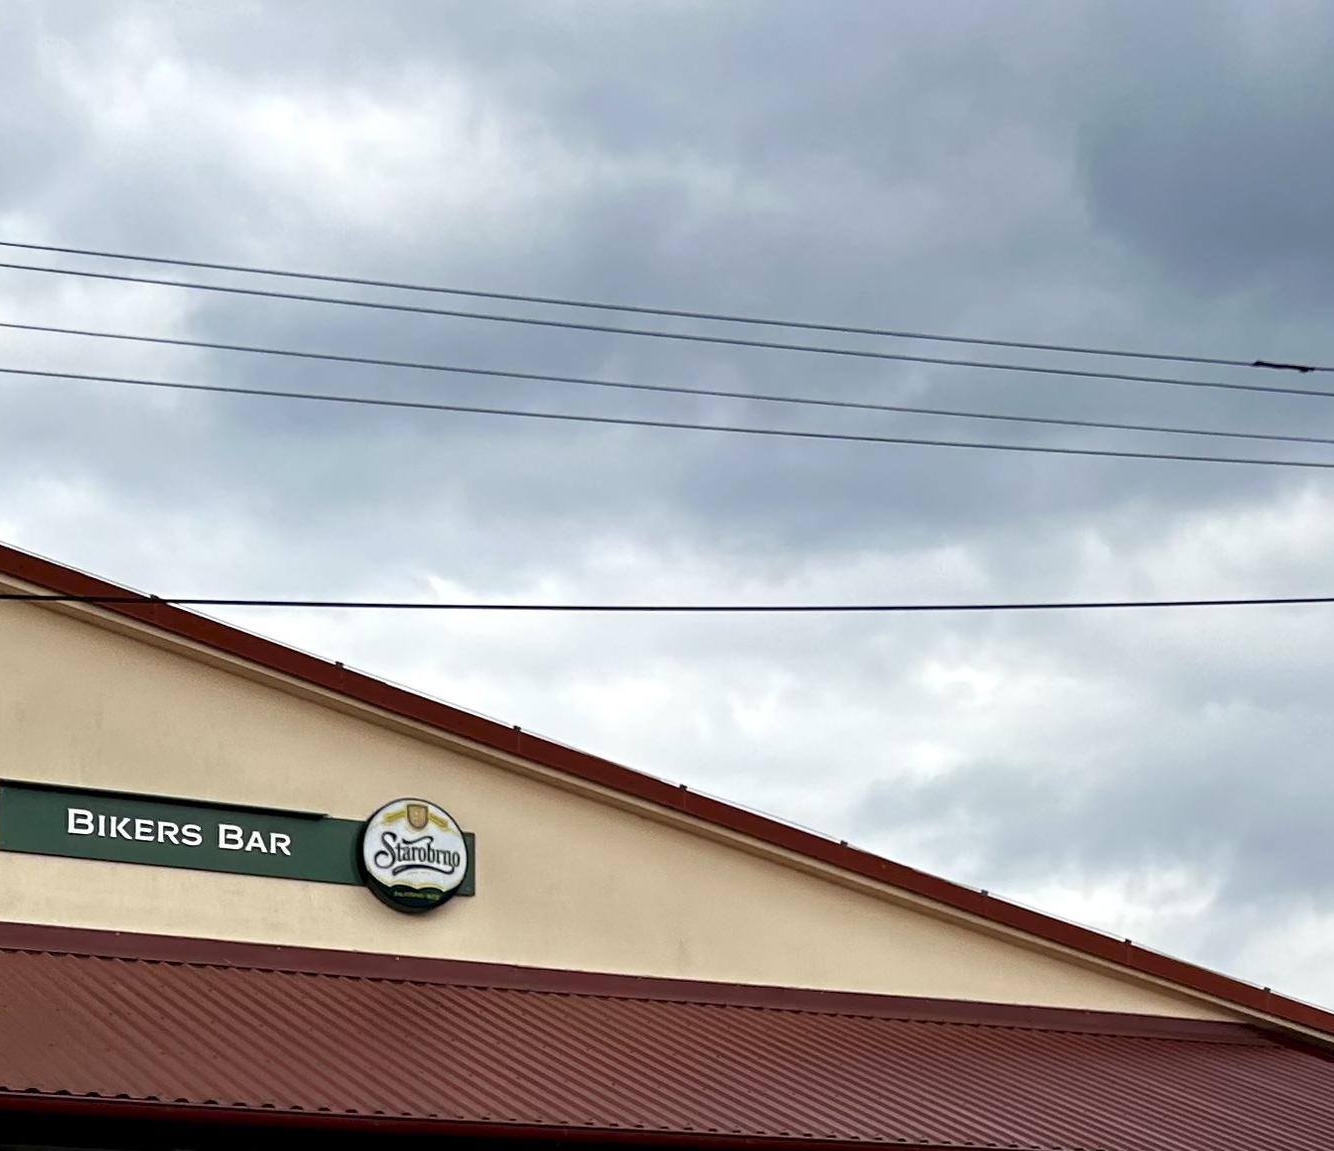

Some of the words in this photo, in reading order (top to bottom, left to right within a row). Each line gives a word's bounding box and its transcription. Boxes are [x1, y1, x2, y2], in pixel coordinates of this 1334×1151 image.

[67, 808, 203, 846] BIKERS
[218, 823, 292, 856] BAR
[374, 831, 461, 876] Starobrno
